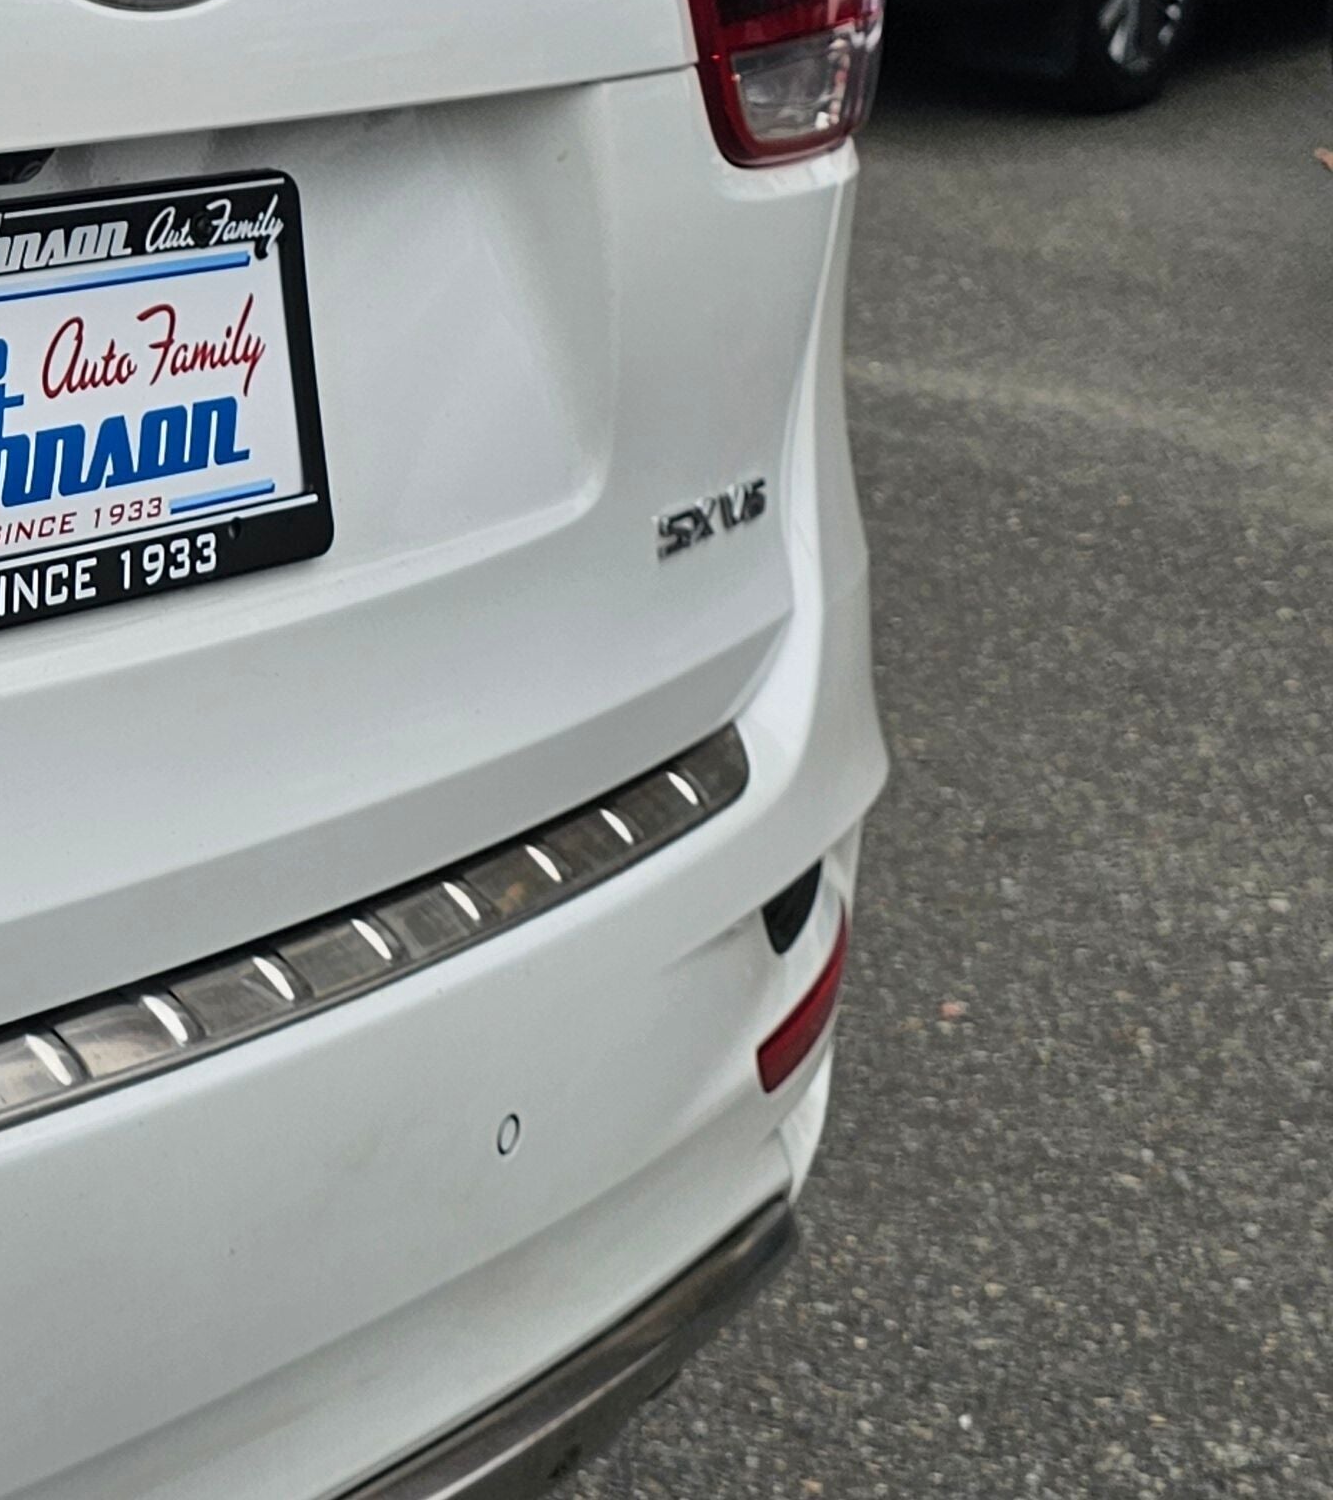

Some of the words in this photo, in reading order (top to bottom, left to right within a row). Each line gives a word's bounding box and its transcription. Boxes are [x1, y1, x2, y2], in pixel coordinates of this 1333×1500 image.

[145, 206, 195, 252] Aut
[206, 194, 284, 252] Family
[41, 316, 136, 399] Auto
[136, 293, 266, 396] Family
[92, 496, 164, 530] 1933
[121, 532, 218, 591] 1933
